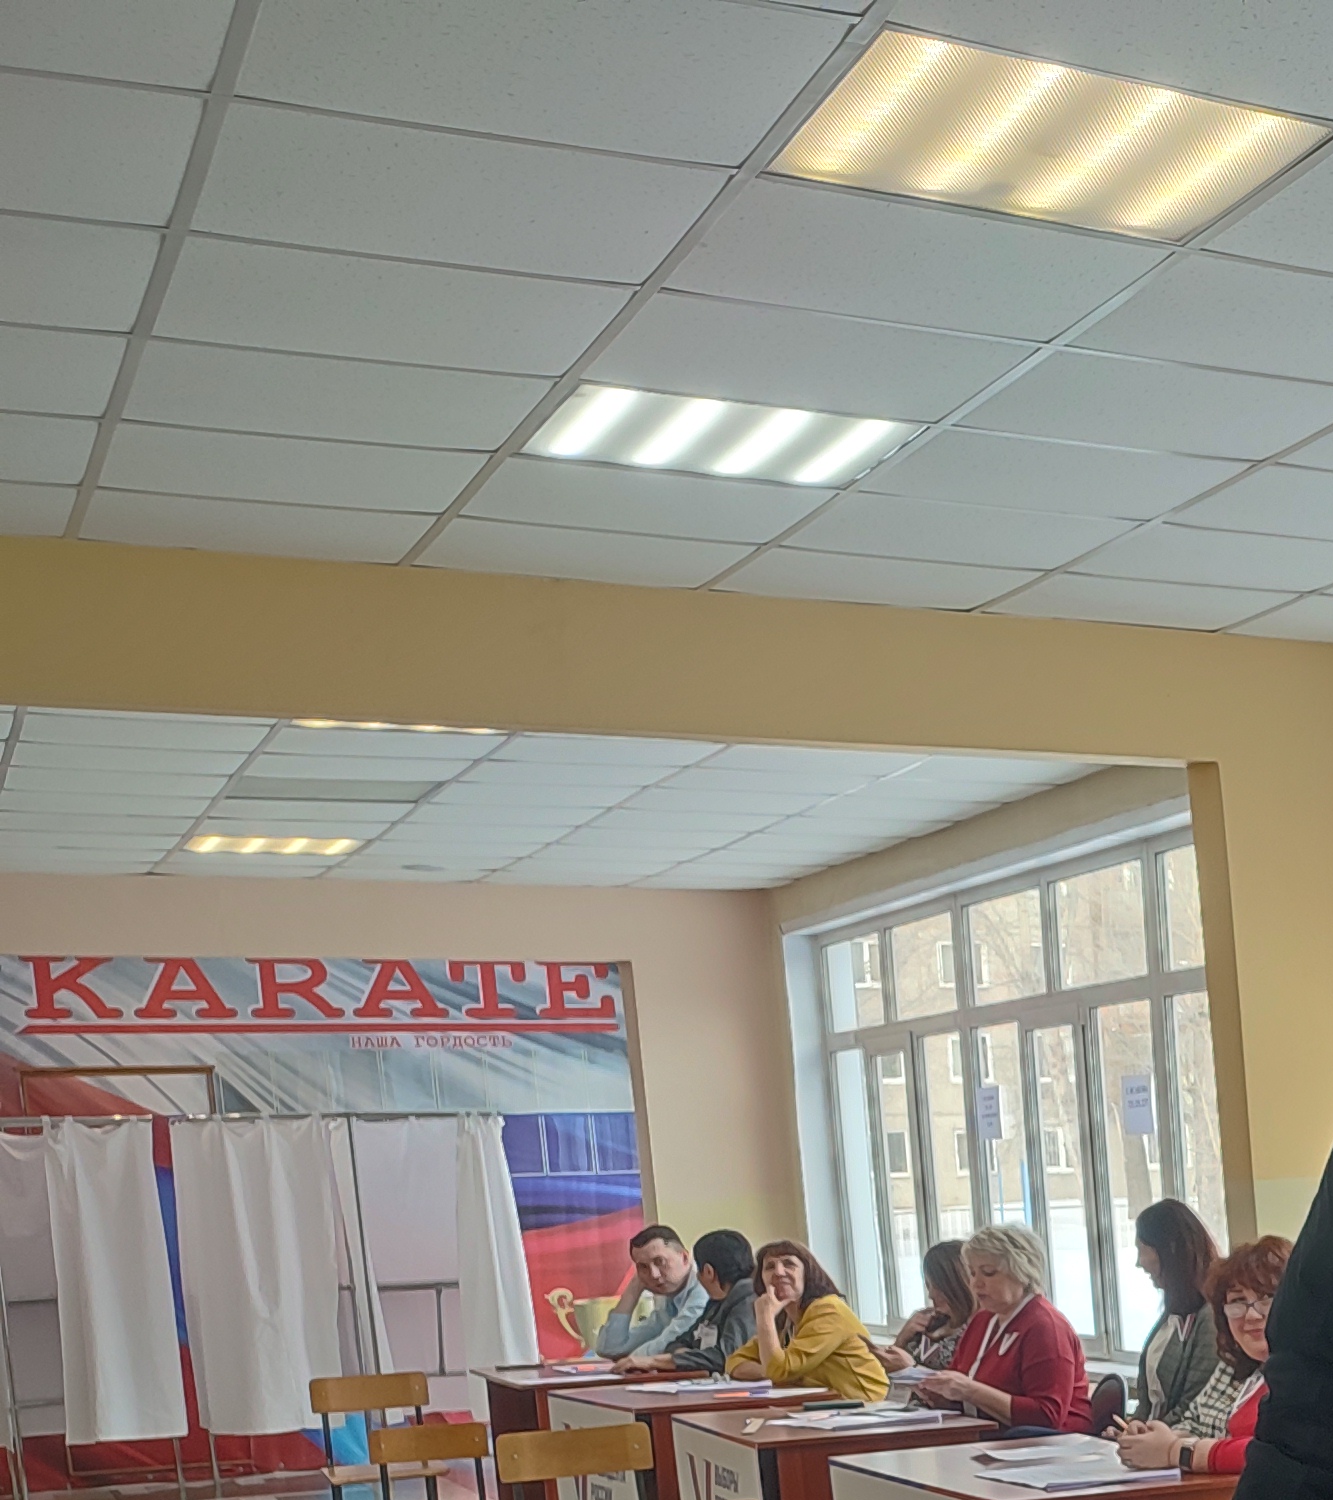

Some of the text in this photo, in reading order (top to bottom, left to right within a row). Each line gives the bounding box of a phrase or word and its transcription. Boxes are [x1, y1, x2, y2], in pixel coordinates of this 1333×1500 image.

[18, 956, 617, 1020] KARATE
[351, 1034, 513, 1049] НАША ГОРДОСТЬ
